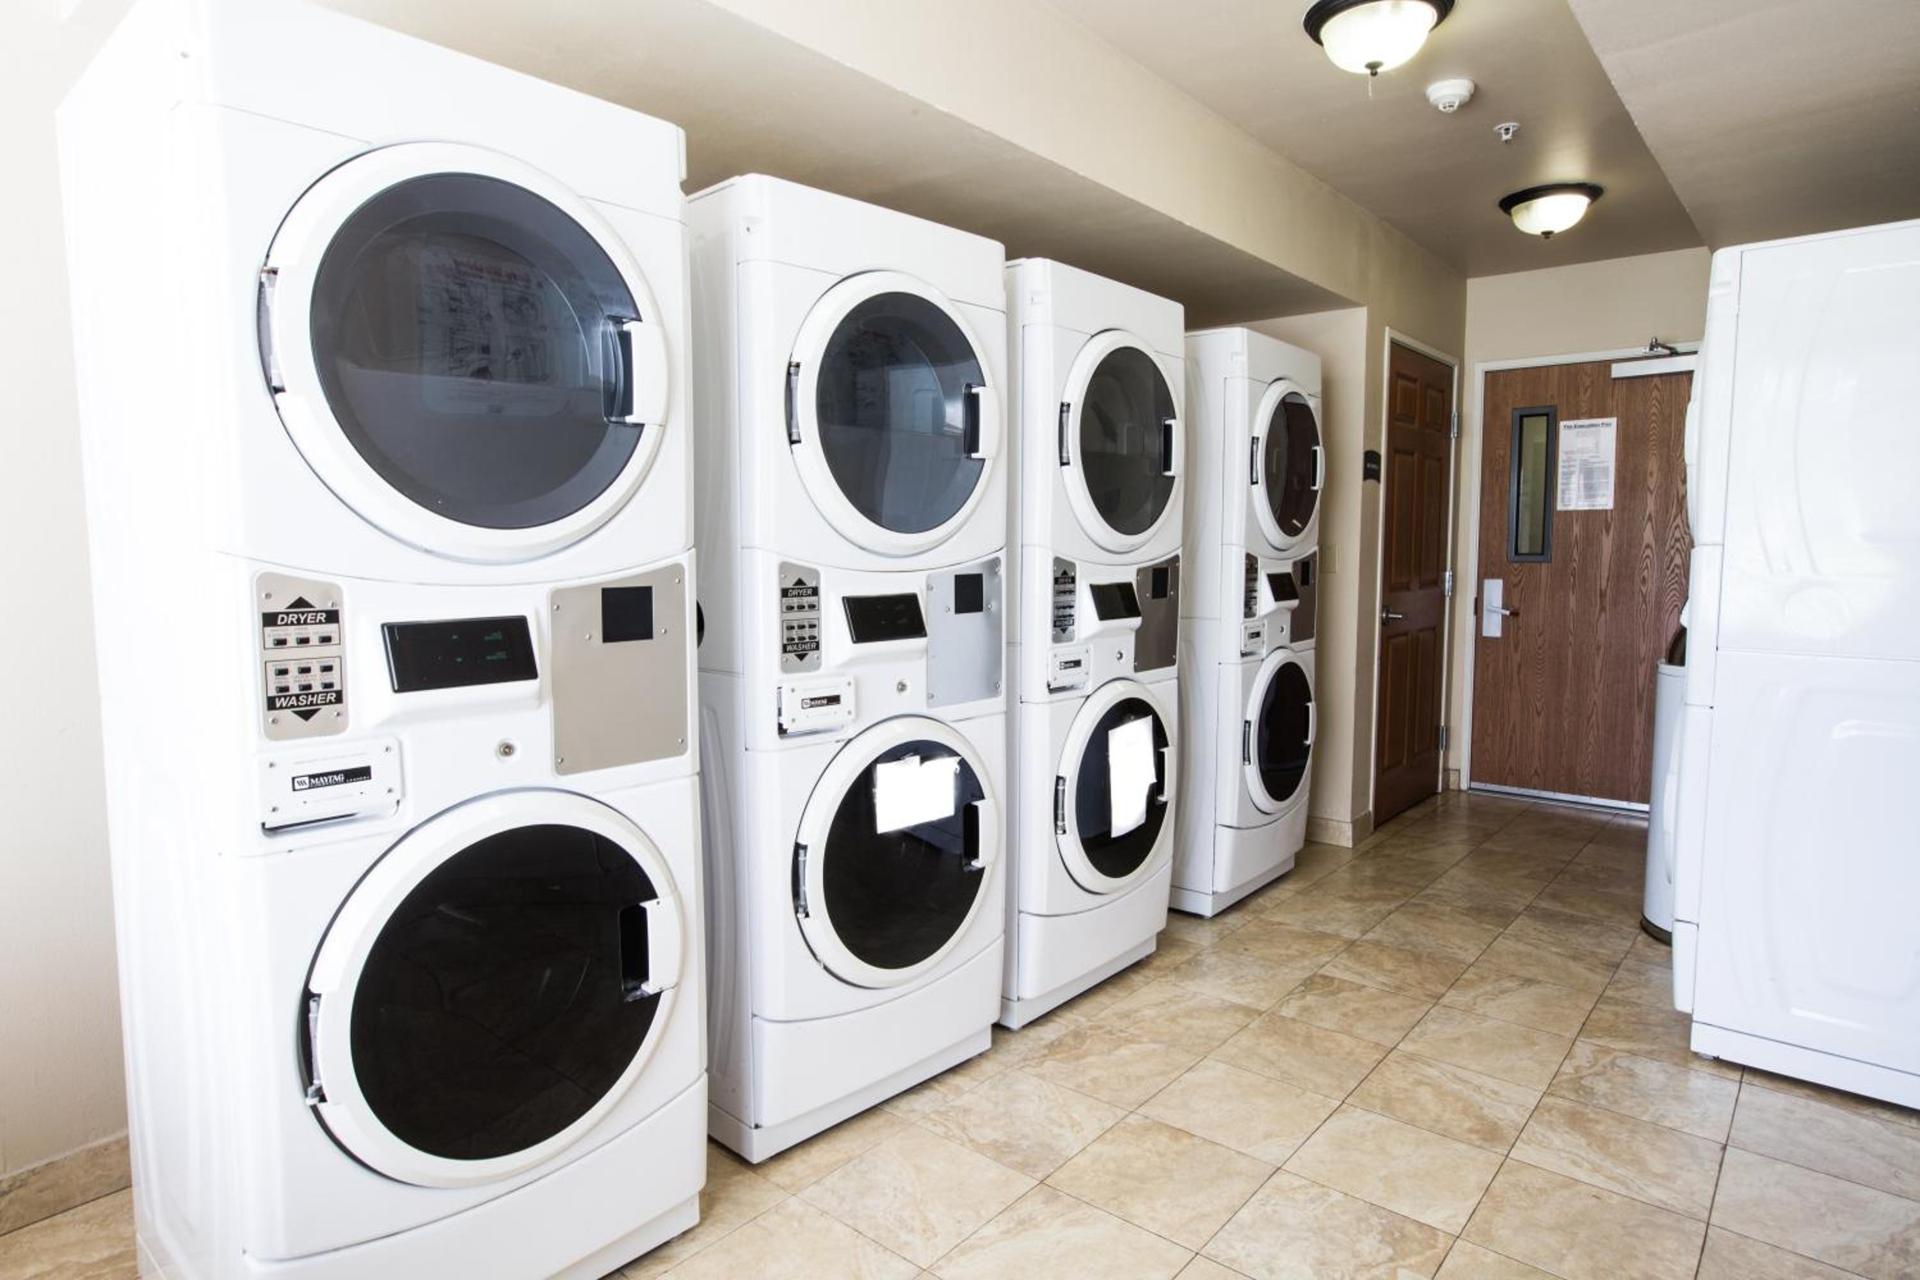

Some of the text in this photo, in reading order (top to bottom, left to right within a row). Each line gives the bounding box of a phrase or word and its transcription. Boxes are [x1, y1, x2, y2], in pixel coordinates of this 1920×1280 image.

[277, 612, 325, 626] DRYER
[275, 692, 336, 708] WASHER
[310, 773, 345, 786] MAYTAG
